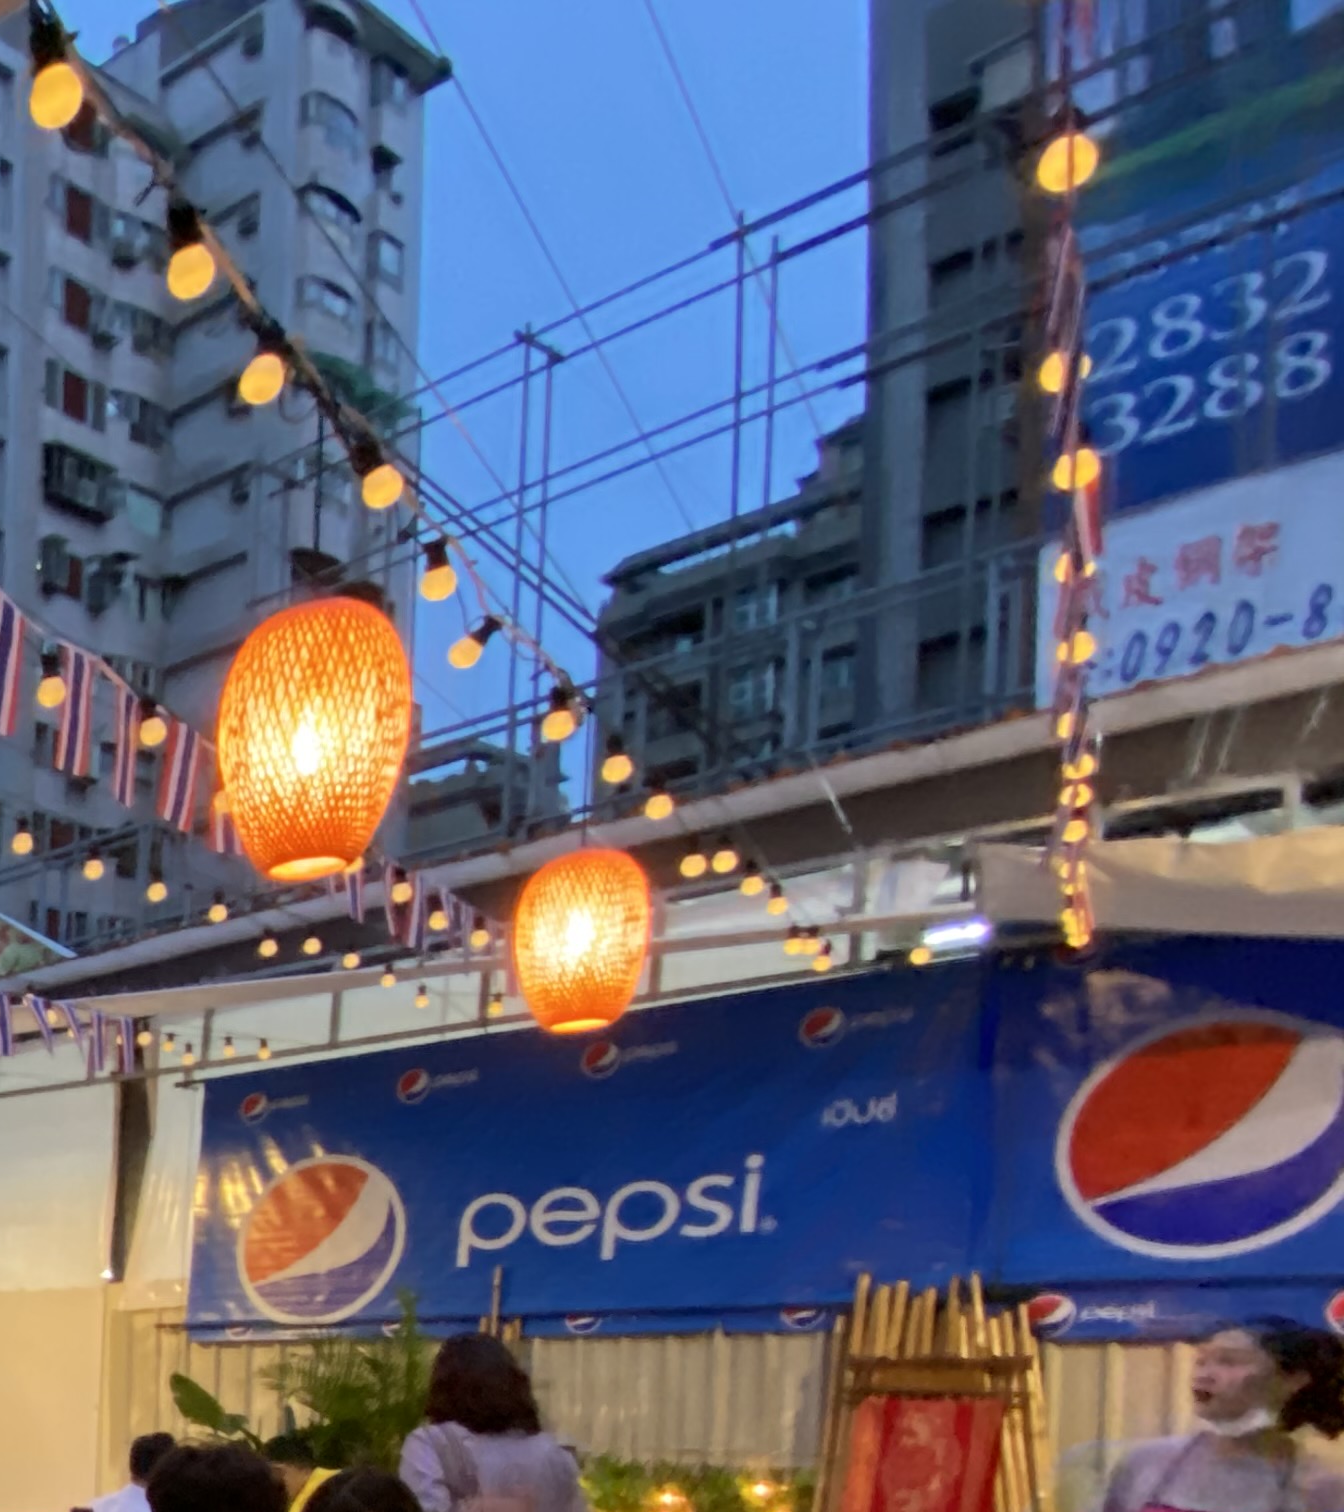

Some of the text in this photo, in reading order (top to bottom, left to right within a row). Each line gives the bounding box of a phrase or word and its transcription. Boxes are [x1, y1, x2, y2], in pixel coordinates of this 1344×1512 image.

[1086, 250, 1332, 382] 2832
[1086, 331, 1331, 456] 3288
[456, 1154, 766, 1268] pepsi
